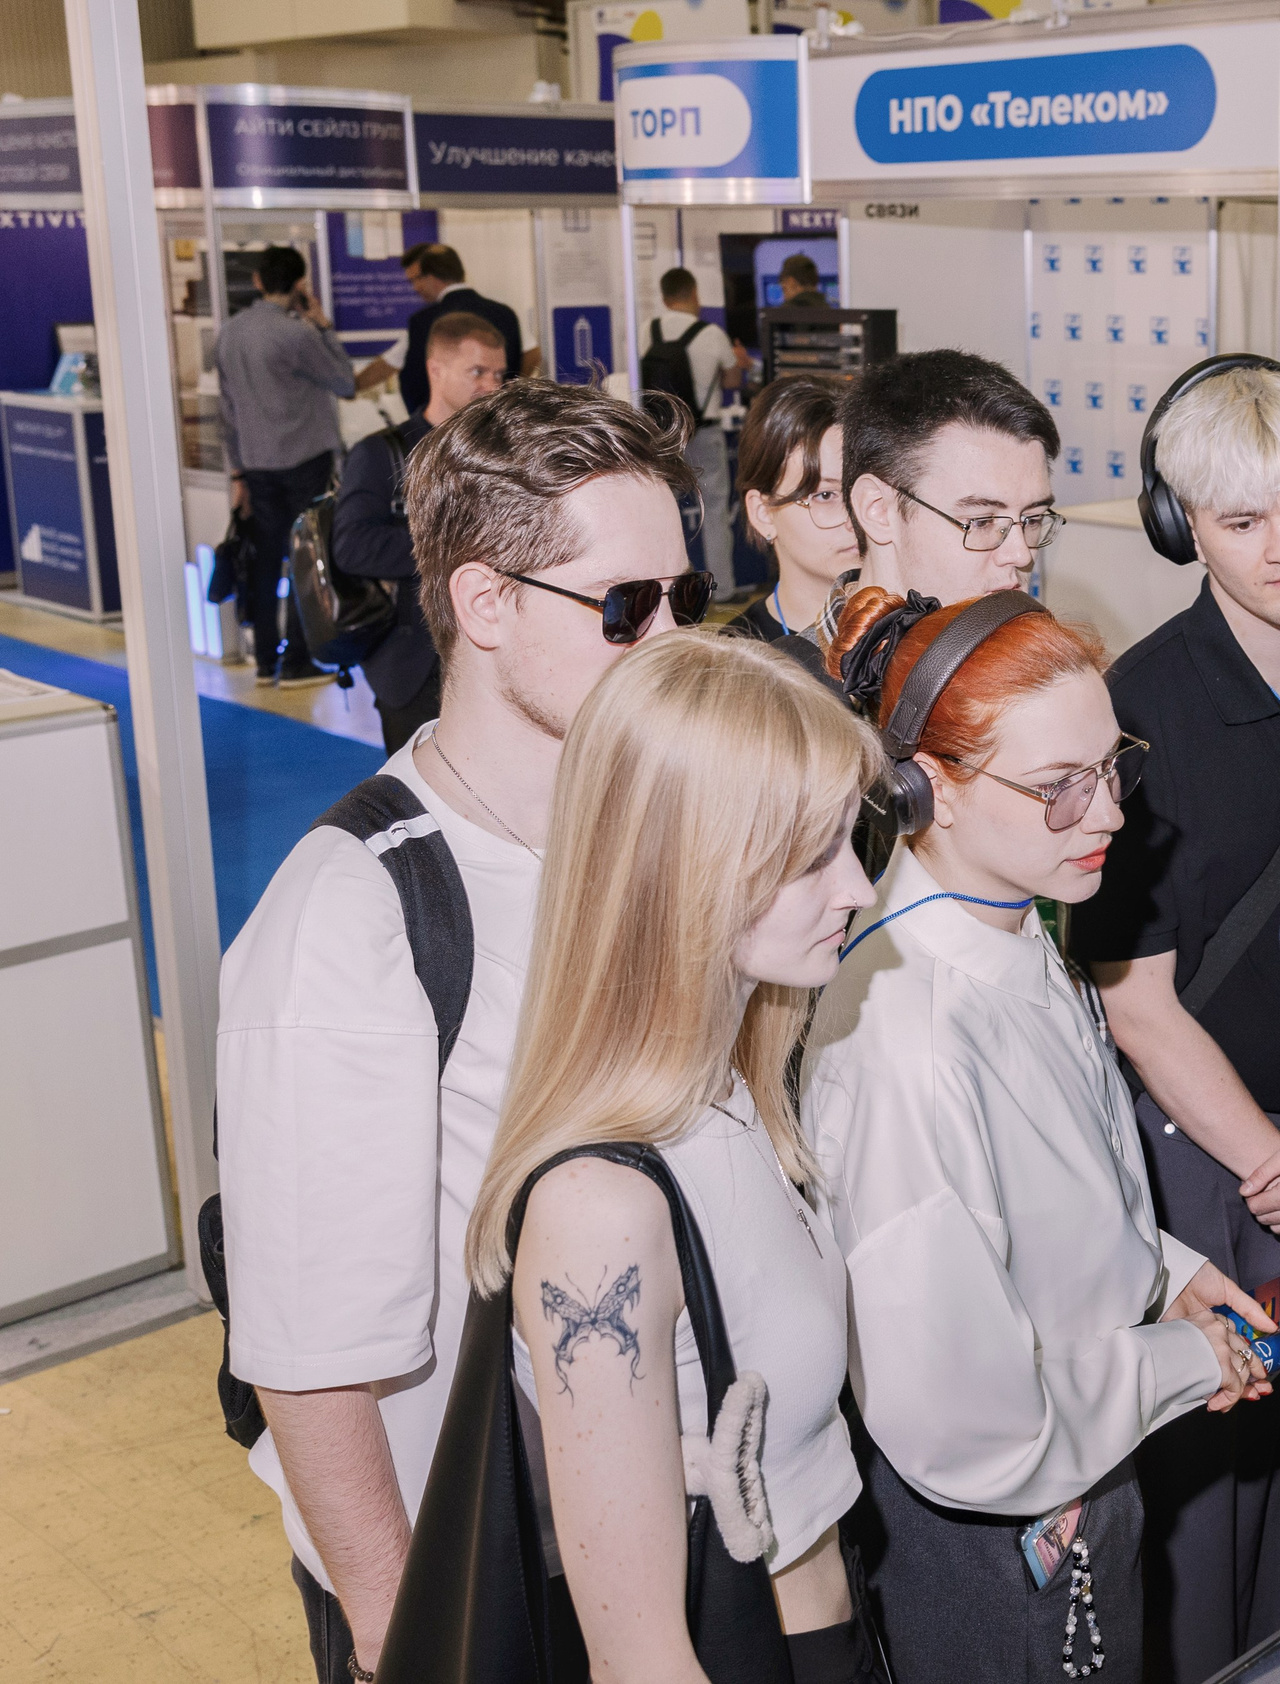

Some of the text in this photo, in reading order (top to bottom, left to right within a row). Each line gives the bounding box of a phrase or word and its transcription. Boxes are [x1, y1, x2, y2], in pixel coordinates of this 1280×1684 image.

[630, 106, 702, 138] ТОРП
[888, 88, 1170, 135] НПО «Телеком»
[428, 140, 616, 169] Улучшение каче
